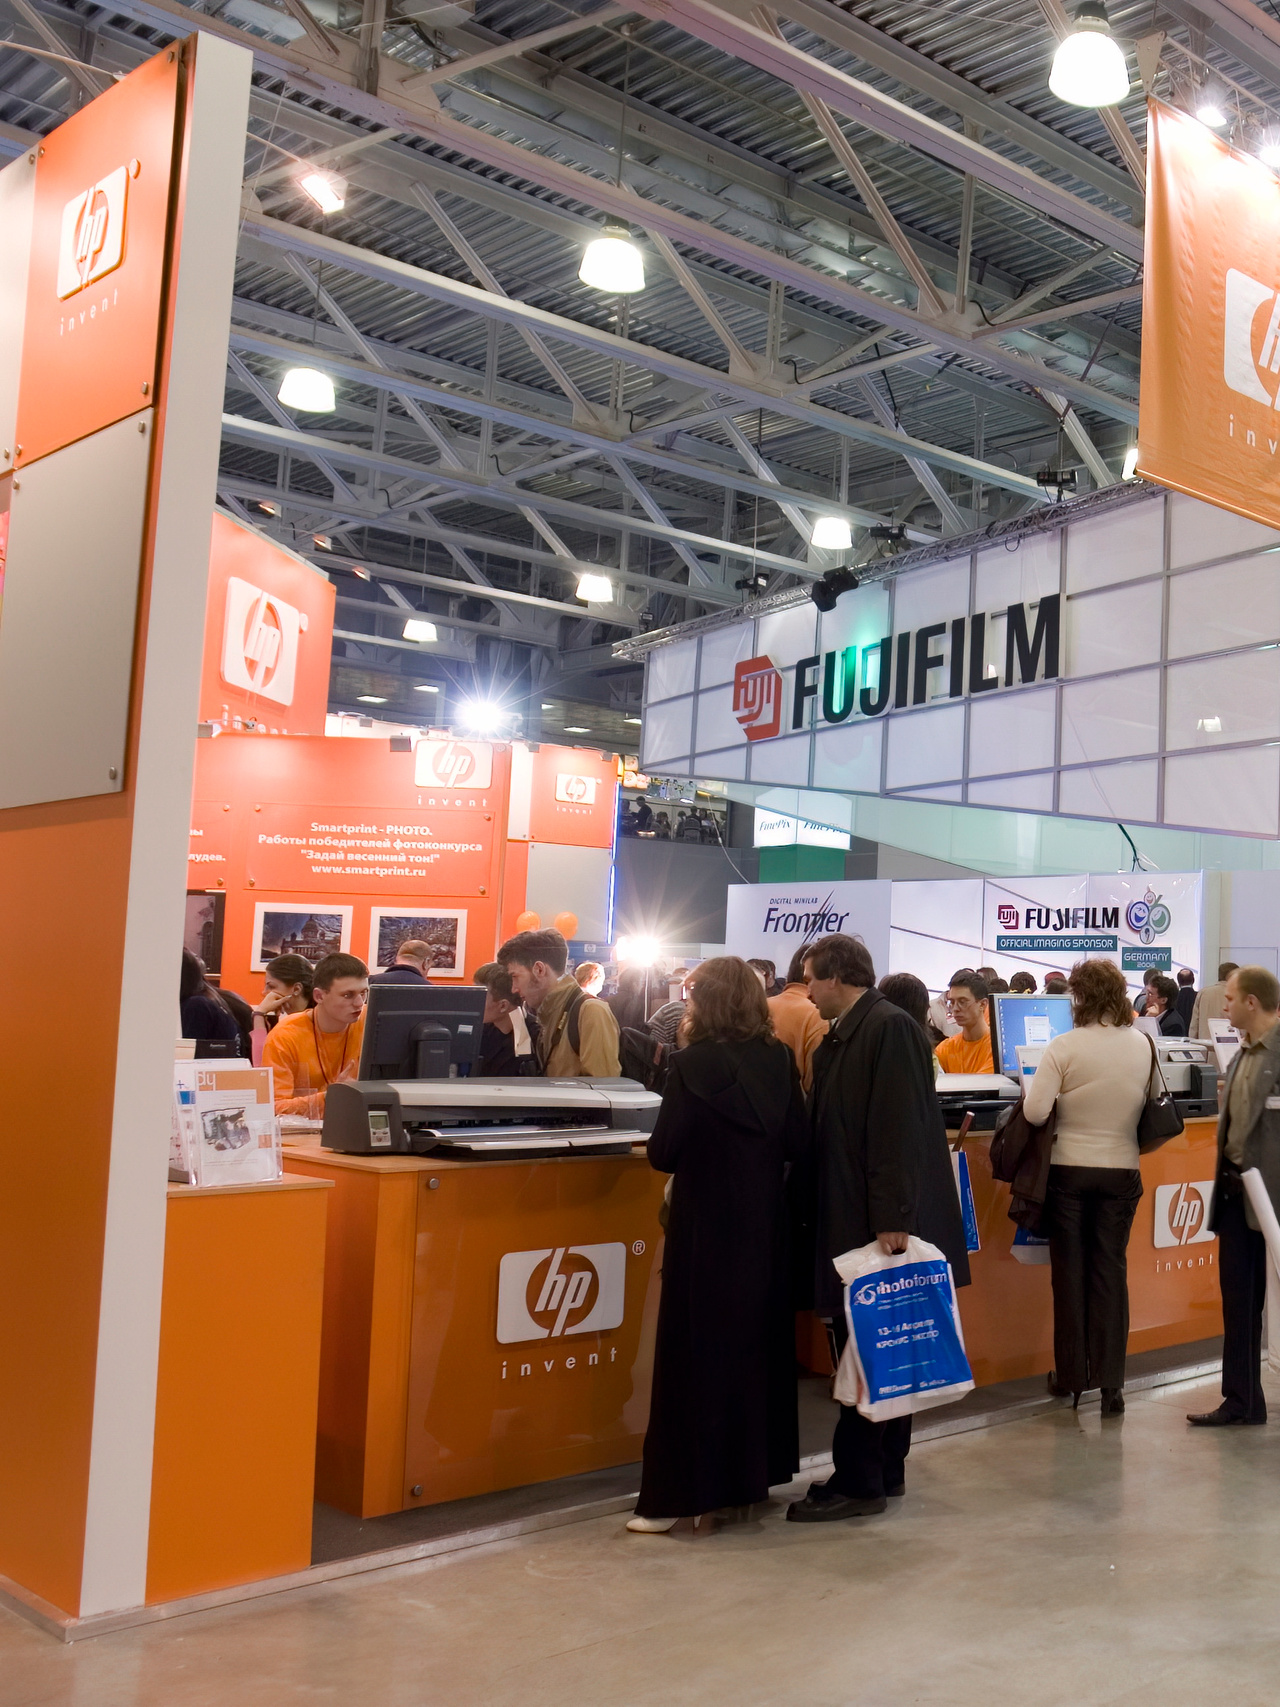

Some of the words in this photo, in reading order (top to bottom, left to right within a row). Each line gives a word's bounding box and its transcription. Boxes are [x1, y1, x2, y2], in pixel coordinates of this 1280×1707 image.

[60, 288, 118, 336] invent
[792, 593, 1062, 730] FUJIFILM
[221, 704, 288, 734] ine
[418, 795, 488, 807] invent
[557, 807, 593, 815] invent
[311, 822, 378, 835] Smartprint
[386, 825, 433, 836] PHOTO.
[258, 834, 307, 845] Работы
[309, 836, 391, 848] победителей
[393, 839, 482, 853] фотоконкурса
[300, 849, 345, 861] "Задай
[347, 853, 406, 862] весенний
[408, 854, 440, 863] тон!"
[311, 866, 426, 877] www.smartprint.ru
[763, 908, 850, 933] Frontier
[1025, 907, 1120, 931] FUJIFILM
[1000, 939, 1032, 948] OFFICIAL
[1034, 938, 1071, 948] IMAGING
[1072, 938, 1113, 948] SPONSOR
[1124, 953, 1169, 961] GERMANY
[1157, 1254, 1213, 1272] invent
[502, 1347, 617, 1379] invent
